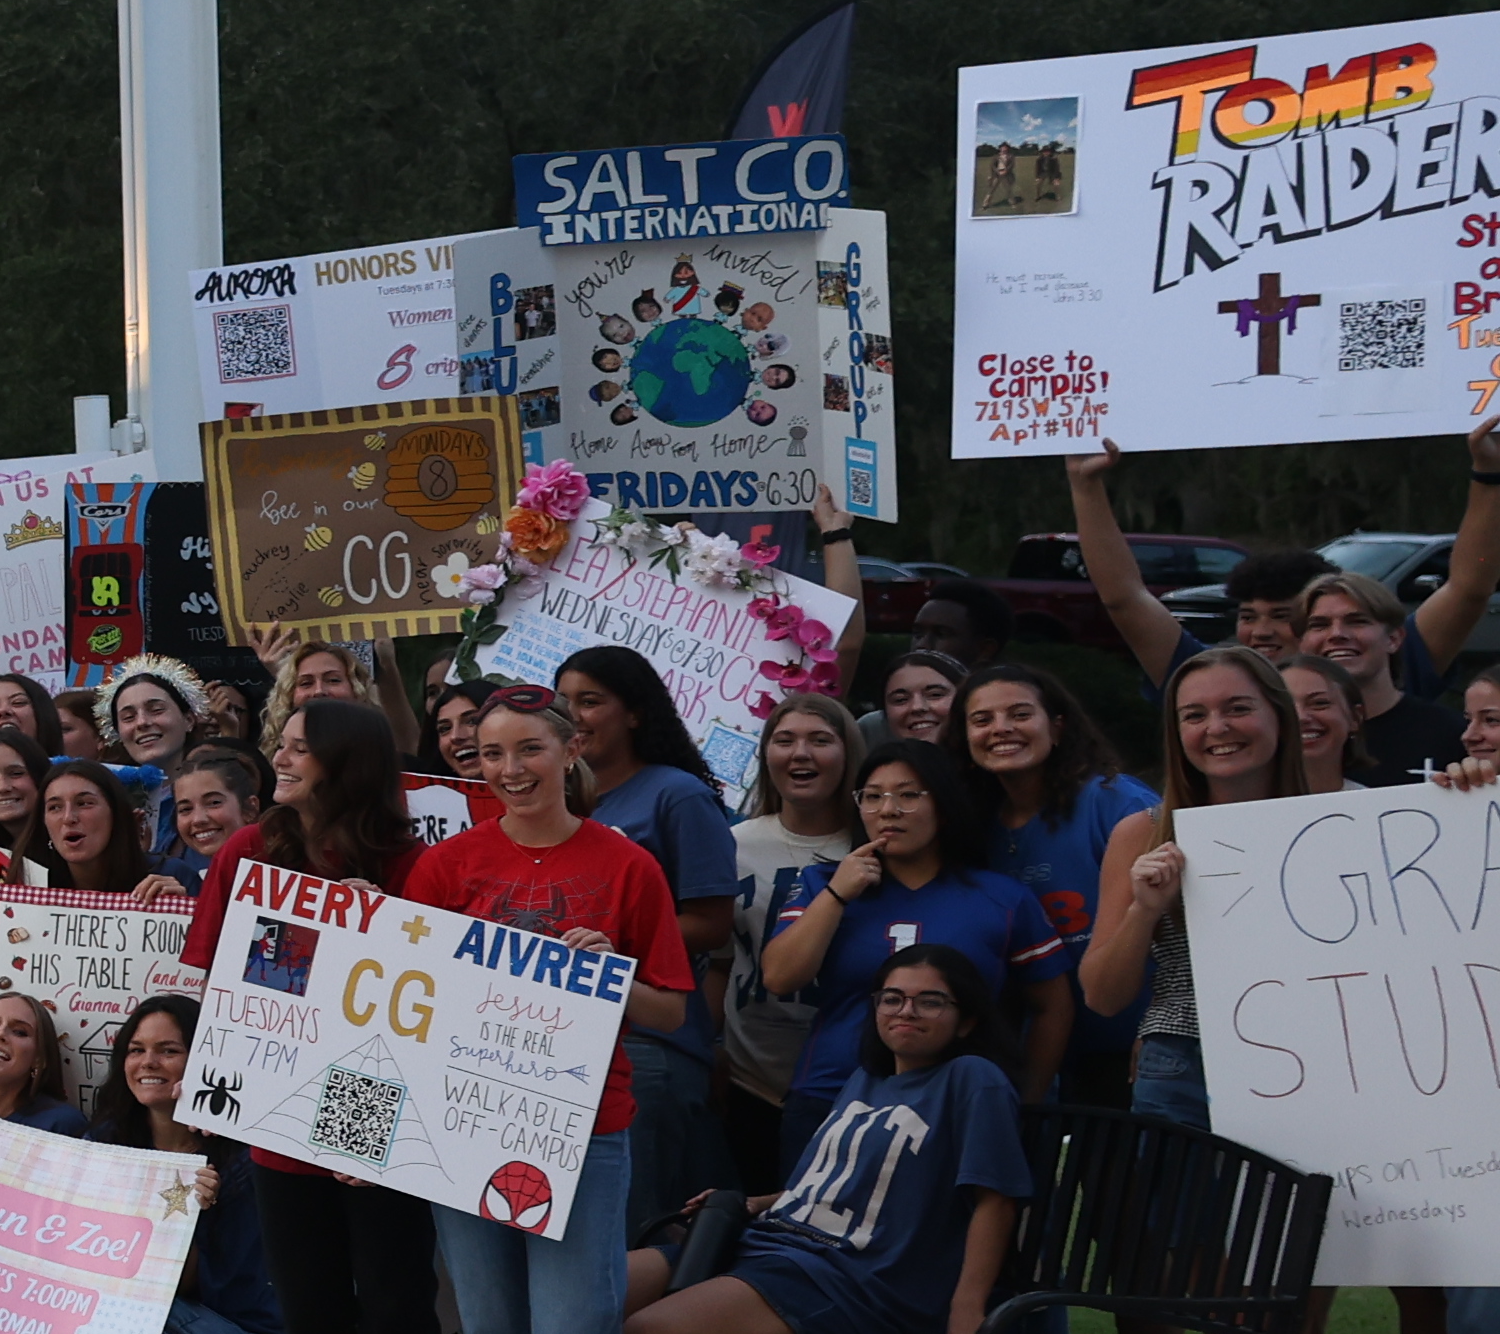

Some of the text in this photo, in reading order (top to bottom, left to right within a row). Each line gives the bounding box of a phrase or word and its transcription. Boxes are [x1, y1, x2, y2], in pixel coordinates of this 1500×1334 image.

[1125, 42, 1437, 164] TOMB
[538, 141, 849, 214] SALT CO.
[195, 263, 296, 303] AURORA
[315, 250, 417, 286] HONORS
[989, 369, 1109, 402] campus!
[399, 430, 488, 457] MONDAYS
[343, 530, 411, 604] CG
[236, 864, 386, 934] AVERY
[30, 953, 133, 991] HIS TABLE
[454, 919, 632, 1003] AIVREE
[210, 987, 321, 1044] TUESDAYS
[342, 958, 435, 1043] CG
[199, 1025, 299, 1076] AT 7PM
[445, 1074, 582, 1138] WALKABLE
[444, 1106, 584, 1171] OFF-CAMPUS
[35, 1215, 65, 1244] &
[66, 1221, 141, 1263] Zoe!
[21, 1284, 92, 1316] 7:00PM
